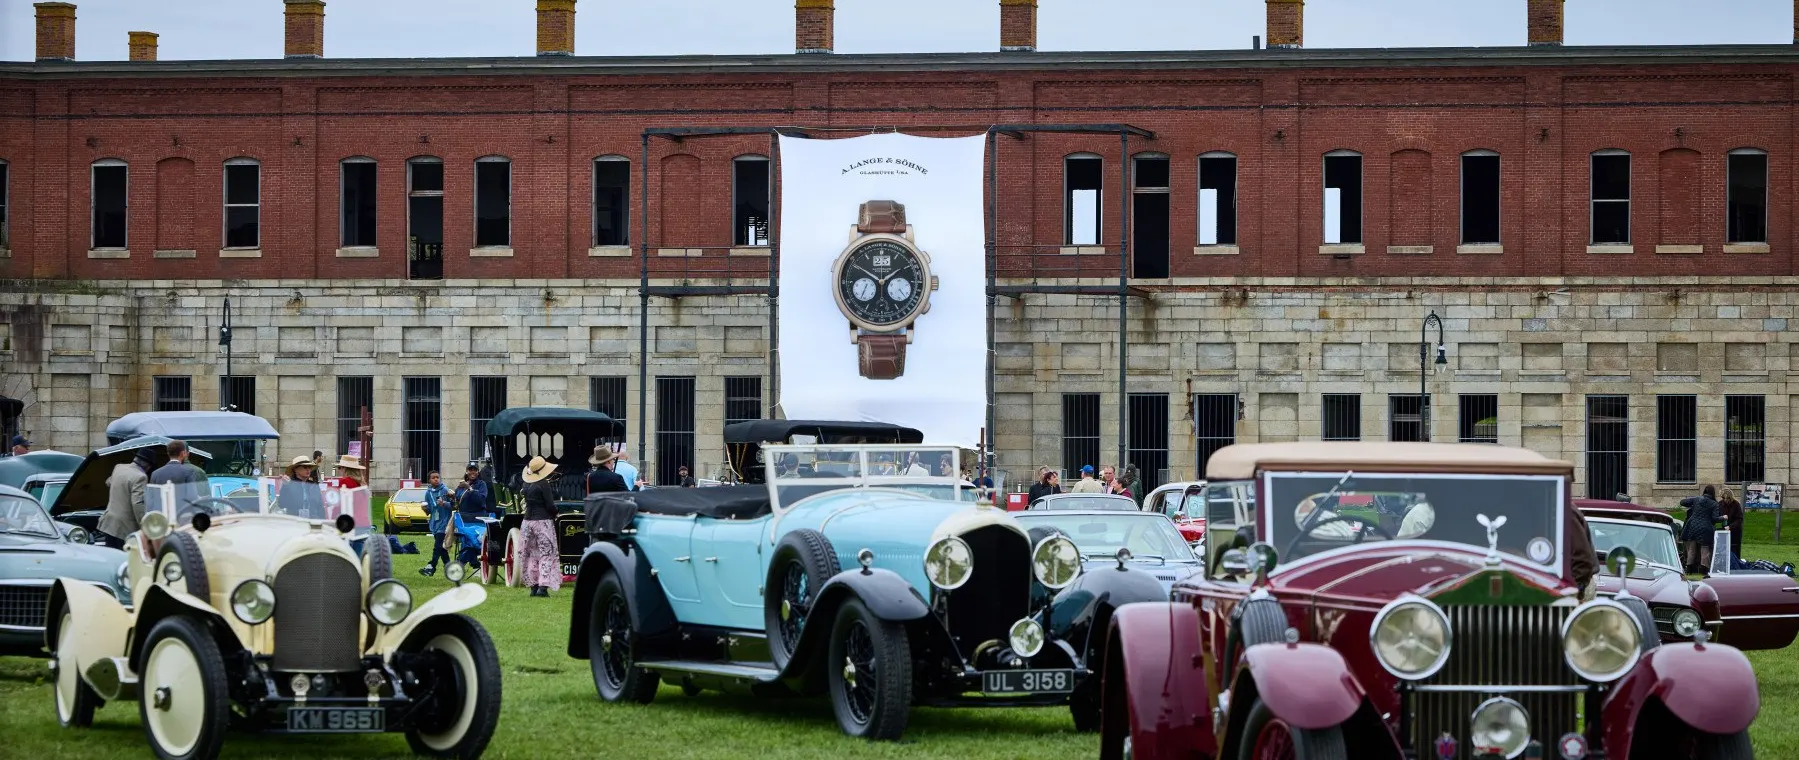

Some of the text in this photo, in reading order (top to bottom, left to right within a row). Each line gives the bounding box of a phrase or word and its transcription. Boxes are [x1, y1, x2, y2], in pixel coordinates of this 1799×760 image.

[895, 158, 928, 175] SÖHNE
[874, 256, 889, 265] 25
[564, 564, 580, 575] C19
[990, 672, 1066, 691] UL 3158
[294, 710, 379, 729] KM 9651
